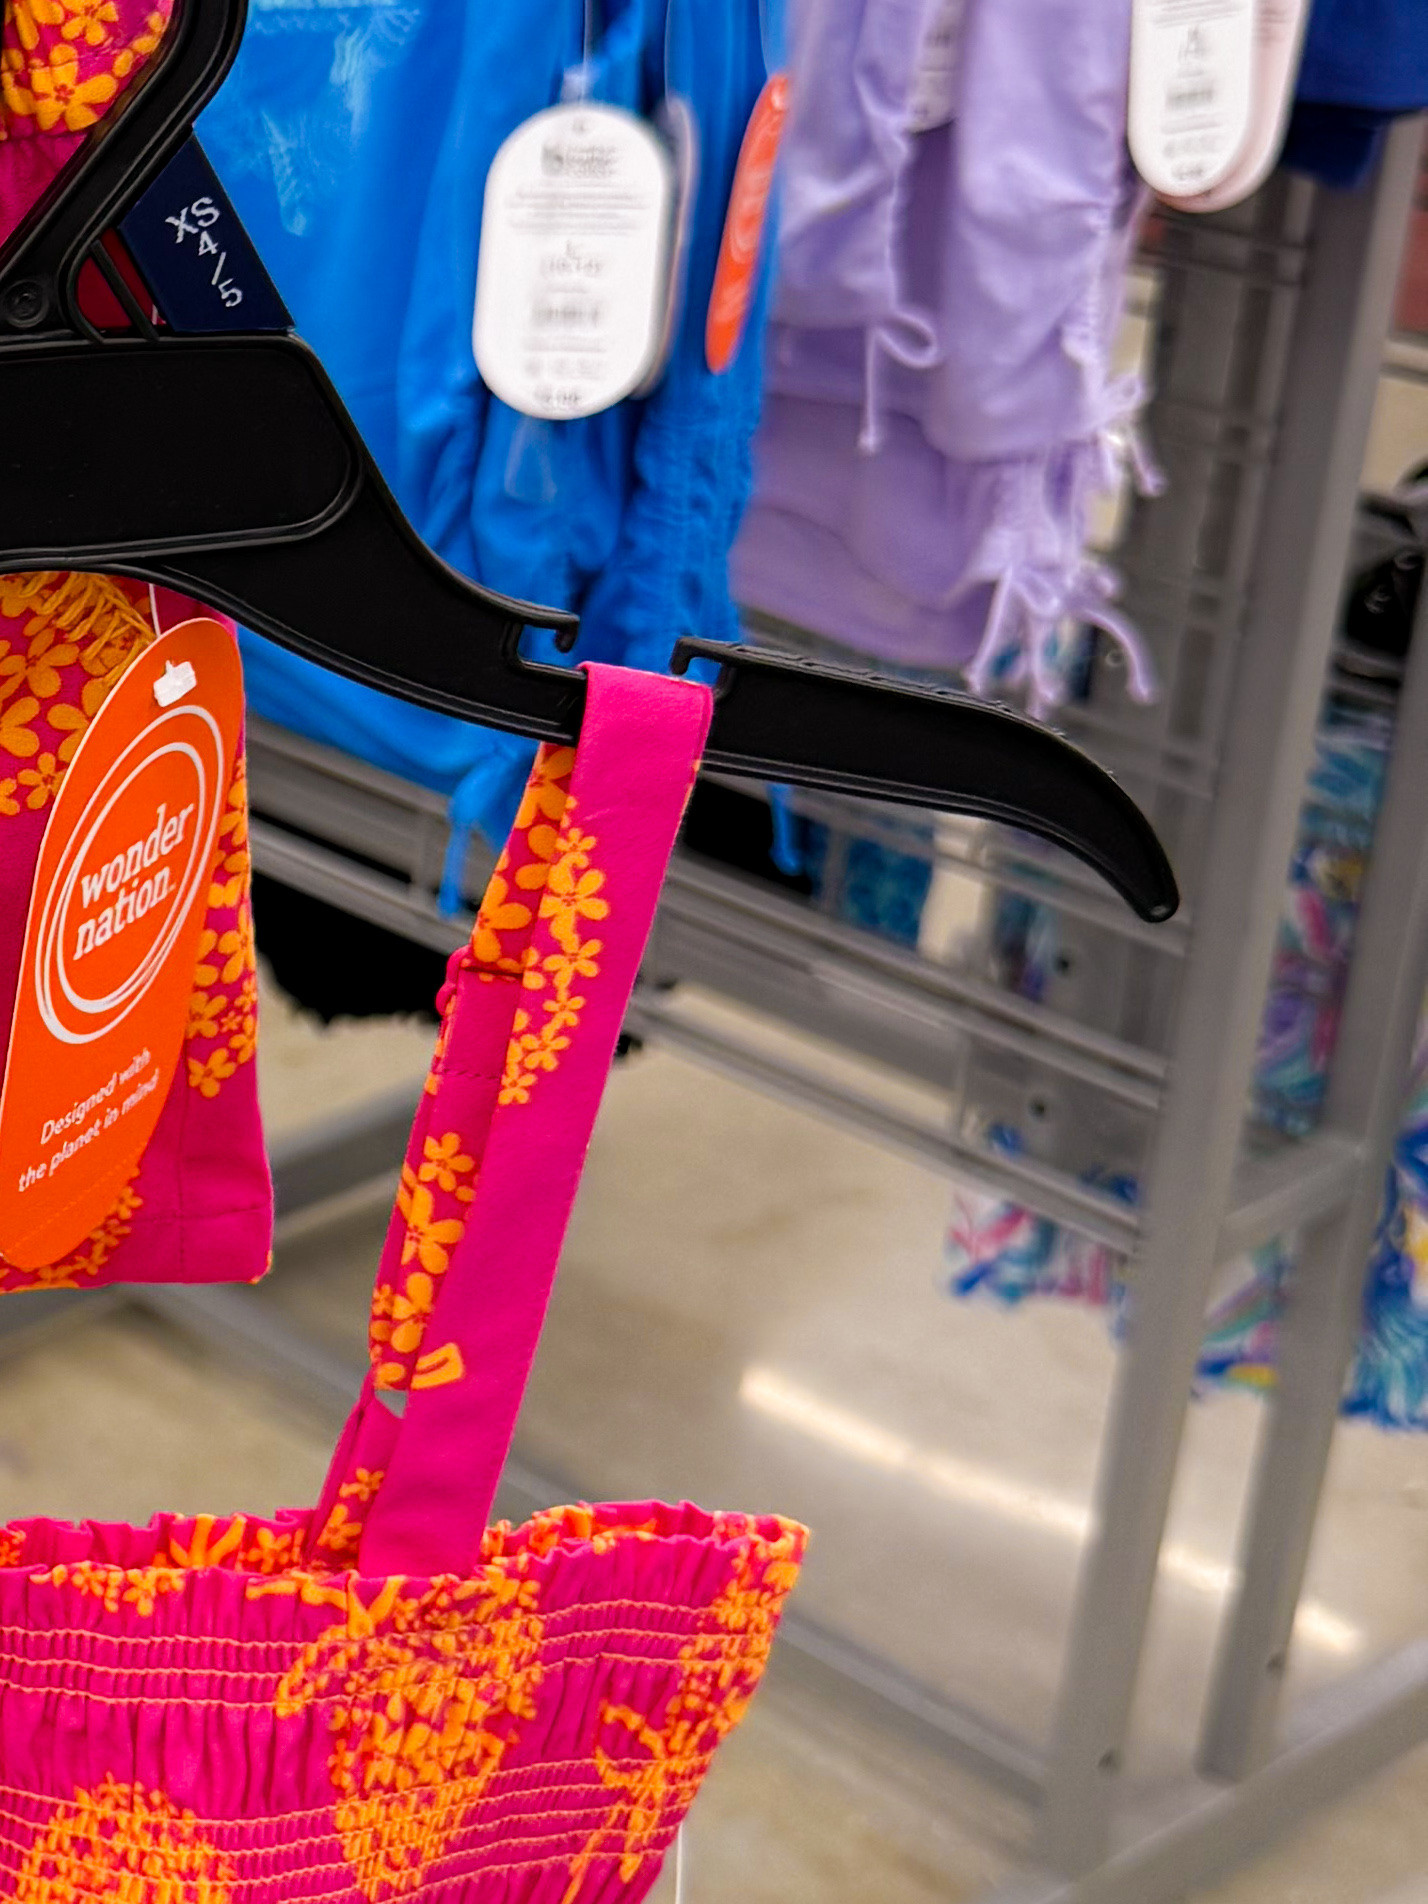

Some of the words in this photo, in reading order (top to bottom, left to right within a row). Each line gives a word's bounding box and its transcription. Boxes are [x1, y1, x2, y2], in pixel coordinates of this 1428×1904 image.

[165, 197, 220, 244] XS
[80, 802, 195, 909] wonder
[40, 1072, 118, 1144] Designed
[118, 1047, 151, 1085] with
[18, 1158, 48, 1193] the
[48, 1120, 101, 1177] planet
[103, 1106, 120, 1129] in
